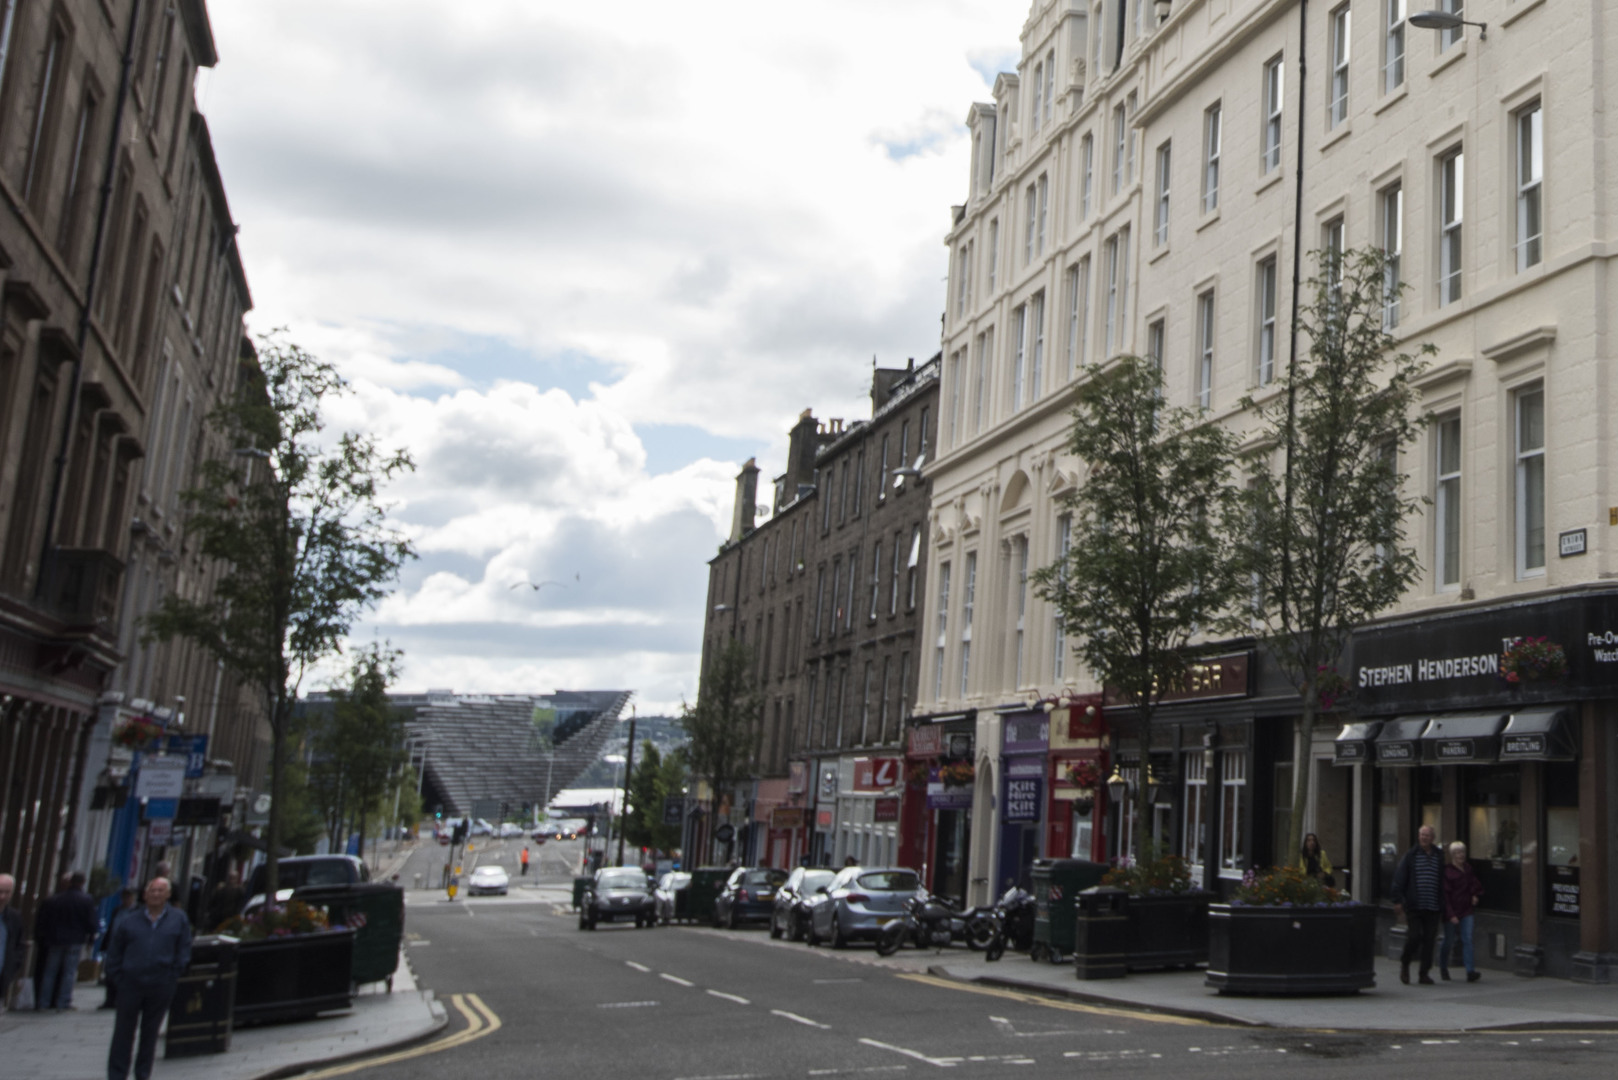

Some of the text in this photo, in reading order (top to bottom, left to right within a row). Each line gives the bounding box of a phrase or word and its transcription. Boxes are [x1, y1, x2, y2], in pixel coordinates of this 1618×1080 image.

[1562, 534, 1583, 546] UNION
[1358, 653, 1498, 688] STEPHEN HENDERSON
[1008, 780, 1036, 792] Kilt
[1007, 800, 1035, 811] Kilt
